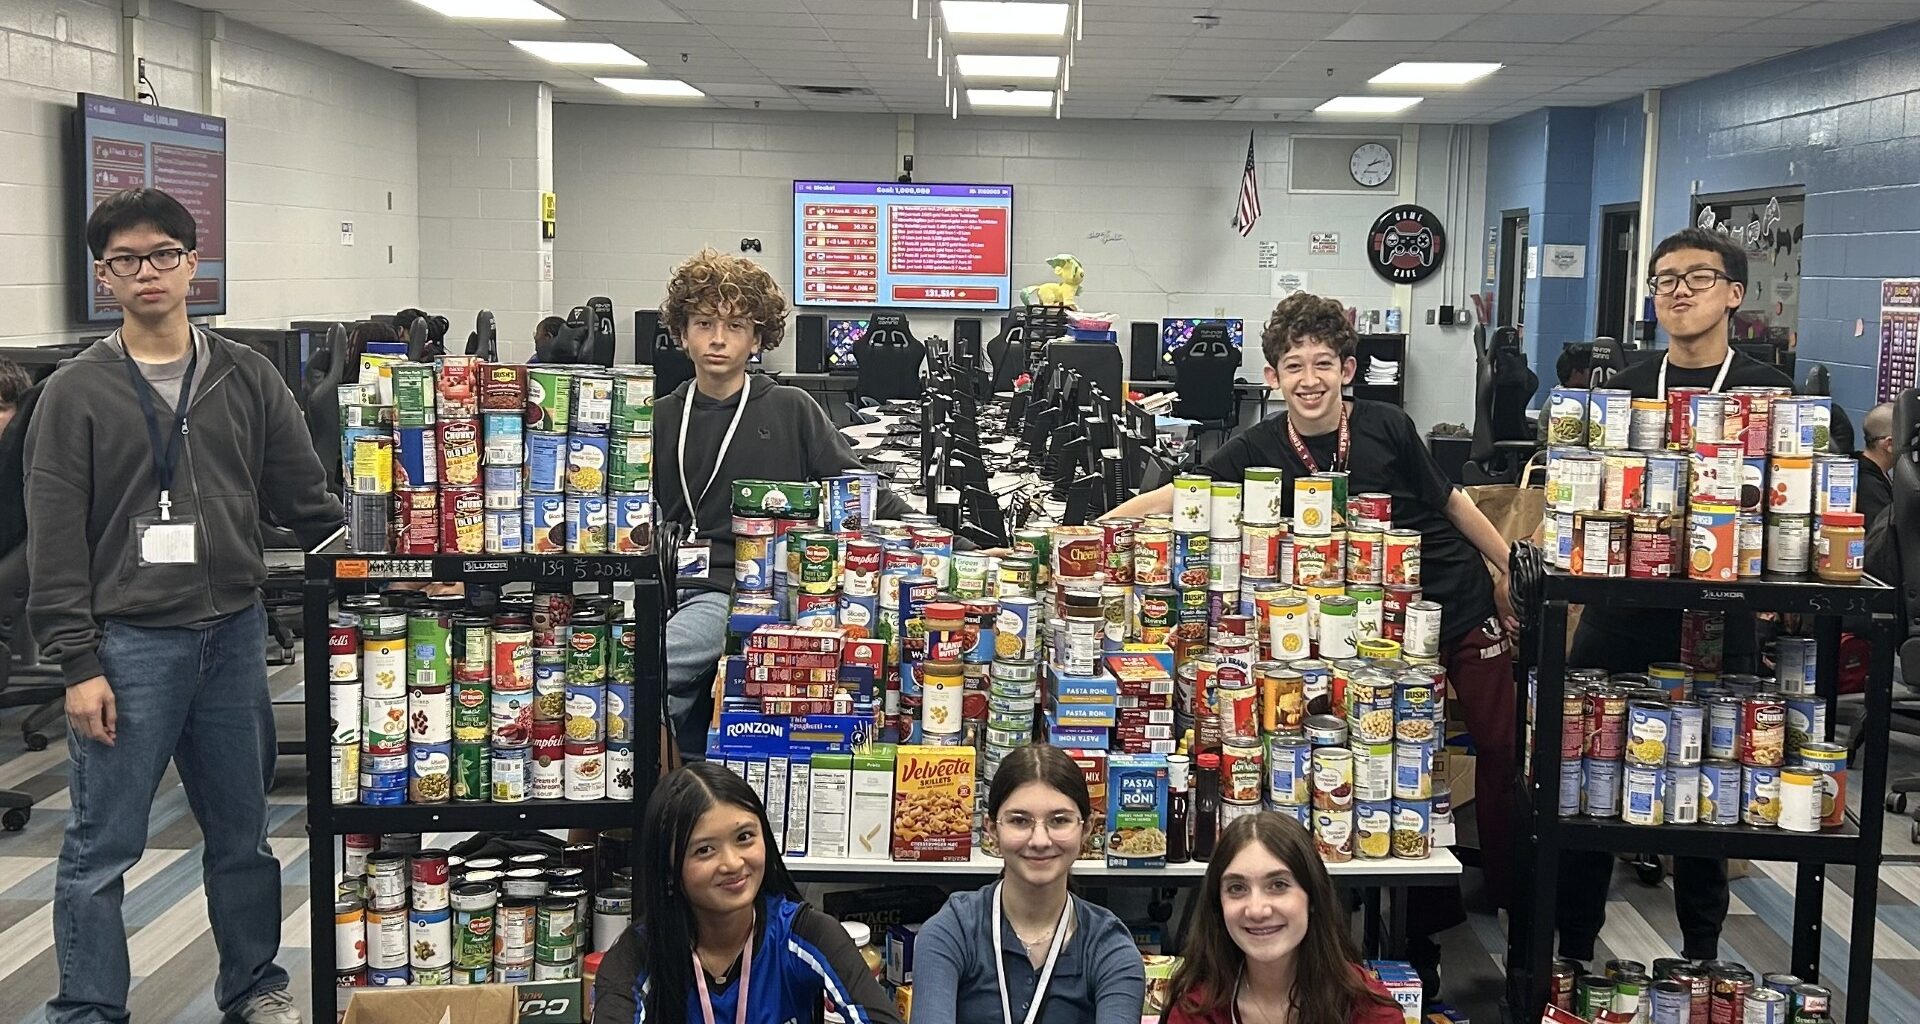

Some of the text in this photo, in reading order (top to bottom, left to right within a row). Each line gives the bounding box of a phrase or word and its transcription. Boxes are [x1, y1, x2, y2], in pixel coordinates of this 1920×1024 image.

[1395, 211, 1423, 222] GAME
[1394, 269, 1416, 278] CAVE
[458, 517, 472, 526] OLD
[846, 551, 879, 565] Campbell's
[542, 560, 564, 576] 139
[329, 635, 348, 646] bell's
[1229, 657, 1248, 669] BRAND
[1405, 691, 1430, 699] BUSH'S
[726, 723, 783, 737] RONZONI
[533, 734, 564, 749] mpbell
[902, 758, 970, 782] Velveeta
[920, 777, 951, 786] SKILLETS
[1086, 772, 1100, 781] MIX
[1123, 779, 1154, 787] PASTA
[1124, 794, 1153, 803] RONI
[1393, 994, 1420, 1002] IFFY
